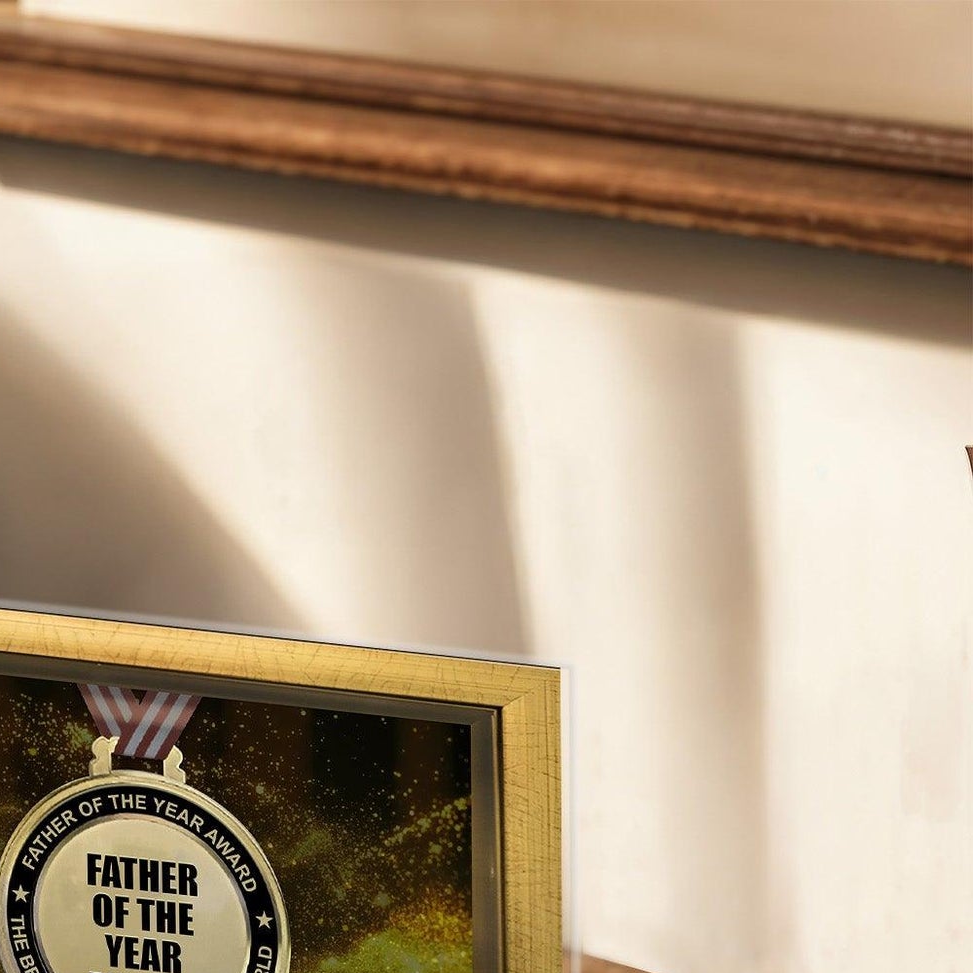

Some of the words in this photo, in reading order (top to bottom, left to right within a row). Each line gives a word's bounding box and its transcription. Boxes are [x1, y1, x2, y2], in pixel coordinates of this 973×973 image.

[22, 809, 78, 870] FATHER
[79, 797, 104, 817] OF
[108, 794, 147, 810] THE
[153, 798, 204, 833] YEAR
[204, 828, 257, 893] AWARD
[87, 853, 198, 896] FATHER
[10, 914, 29, 951] THE
[93, 893, 130, 928] OF
[136, 899, 194, 936] THE
[104, 934, 182, 973] YEAR
